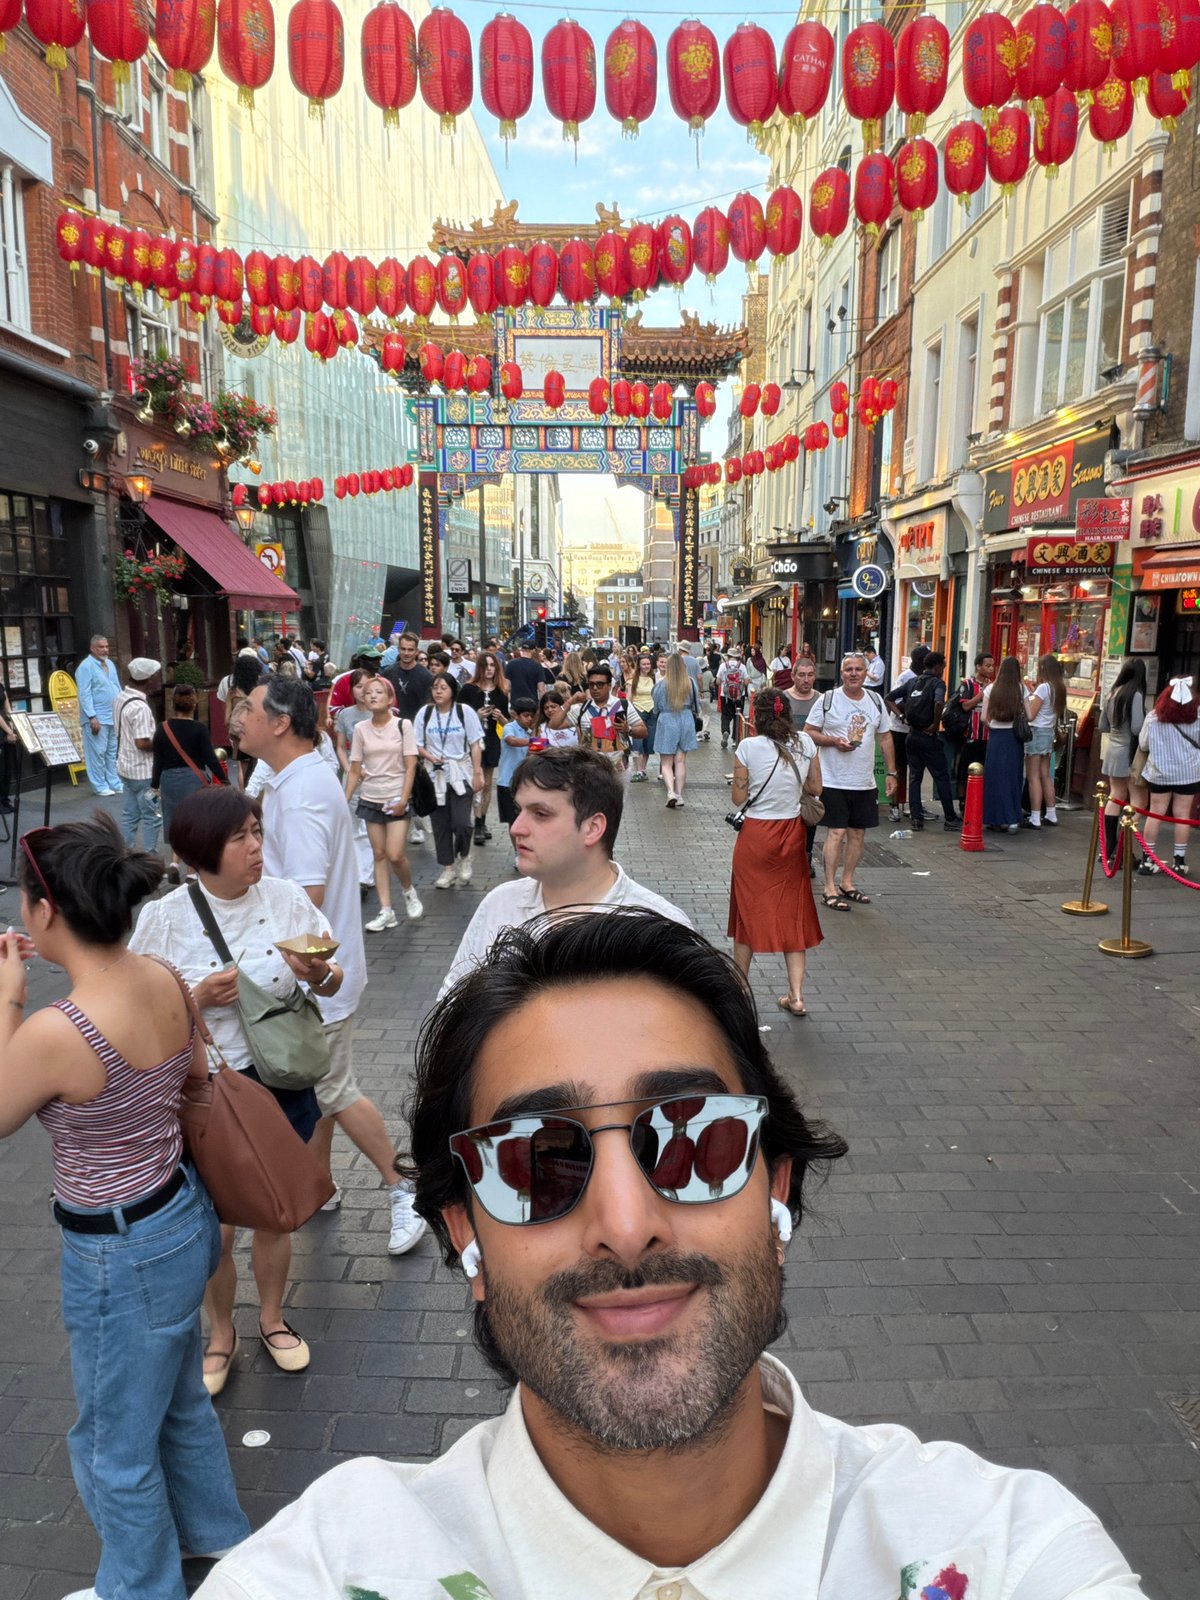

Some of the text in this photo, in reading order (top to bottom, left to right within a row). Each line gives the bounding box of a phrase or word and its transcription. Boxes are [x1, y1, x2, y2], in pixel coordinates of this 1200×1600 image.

[792, 54, 827, 68] CATHAY
[988, 463, 1104, 512] Four Seasons
[1014, 457, 1066, 505] 文興酒家
[1011, 504, 1064, 526] CHINESE RESTAURANT
[1080, 501, 1119, 525] 彩虹
[1077, 526, 1129, 536] RAINBOW
[1037, 544, 1107, 563] 文興酒家
[1032, 566, 1112, 575] CHINESE RESTAURANT
[1160, 572, 1198, 584] CHINATOWN
